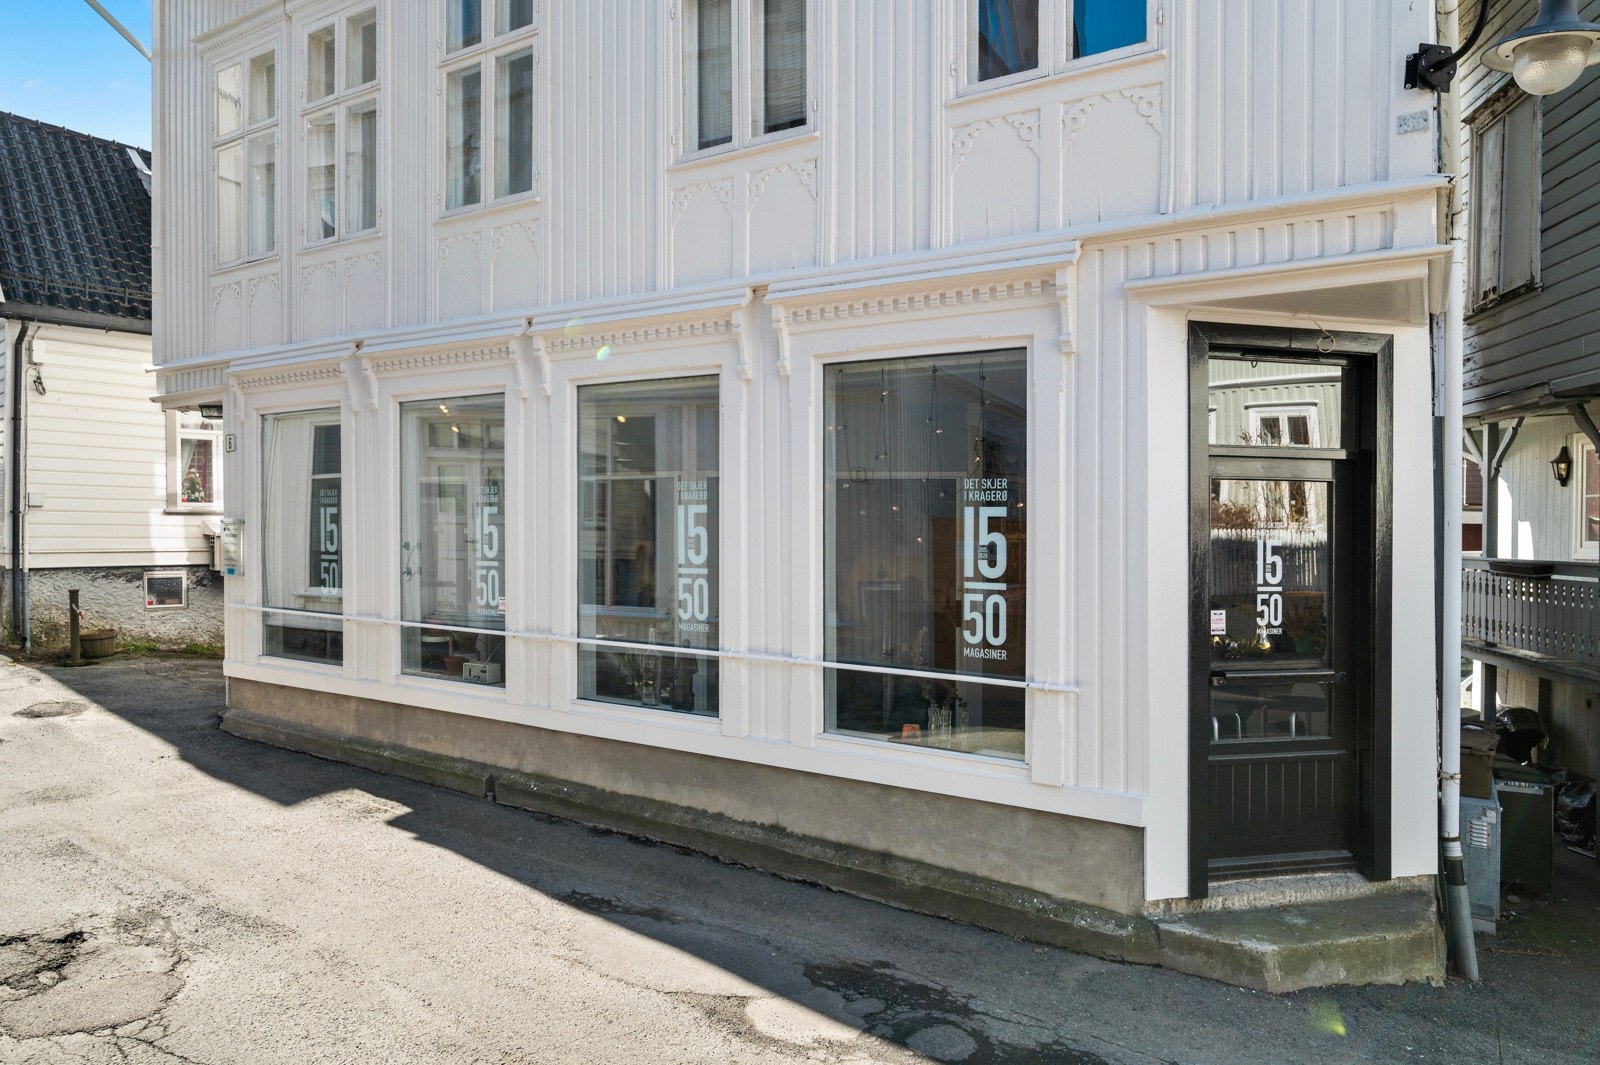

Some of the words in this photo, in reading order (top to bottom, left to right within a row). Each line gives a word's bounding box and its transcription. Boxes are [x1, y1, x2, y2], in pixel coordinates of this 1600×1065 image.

[677, 481, 687, 491] DET
[689, 480, 708, 490] SKJER
[964, 478, 979, 489] DET
[981, 478, 1008, 489] SKJER
[968, 490, 1008, 502] KRAGERØ
[320, 507, 338, 553] 15
[475, 506, 499, 558] 15
[677, 504, 708, 565] 15
[964, 506, 1008, 579] 15
[321, 562, 338, 595] 50
[1257, 539, 1283, 585] 15
[476, 569, 499, 606] 50
[678, 577, 709, 621] 50
[678, 622, 710, 633] MAGASINER
[963, 593, 1007, 646] 50
[1256, 593, 1283, 626] 50
[963, 647, 1007, 661] MAGASINER
